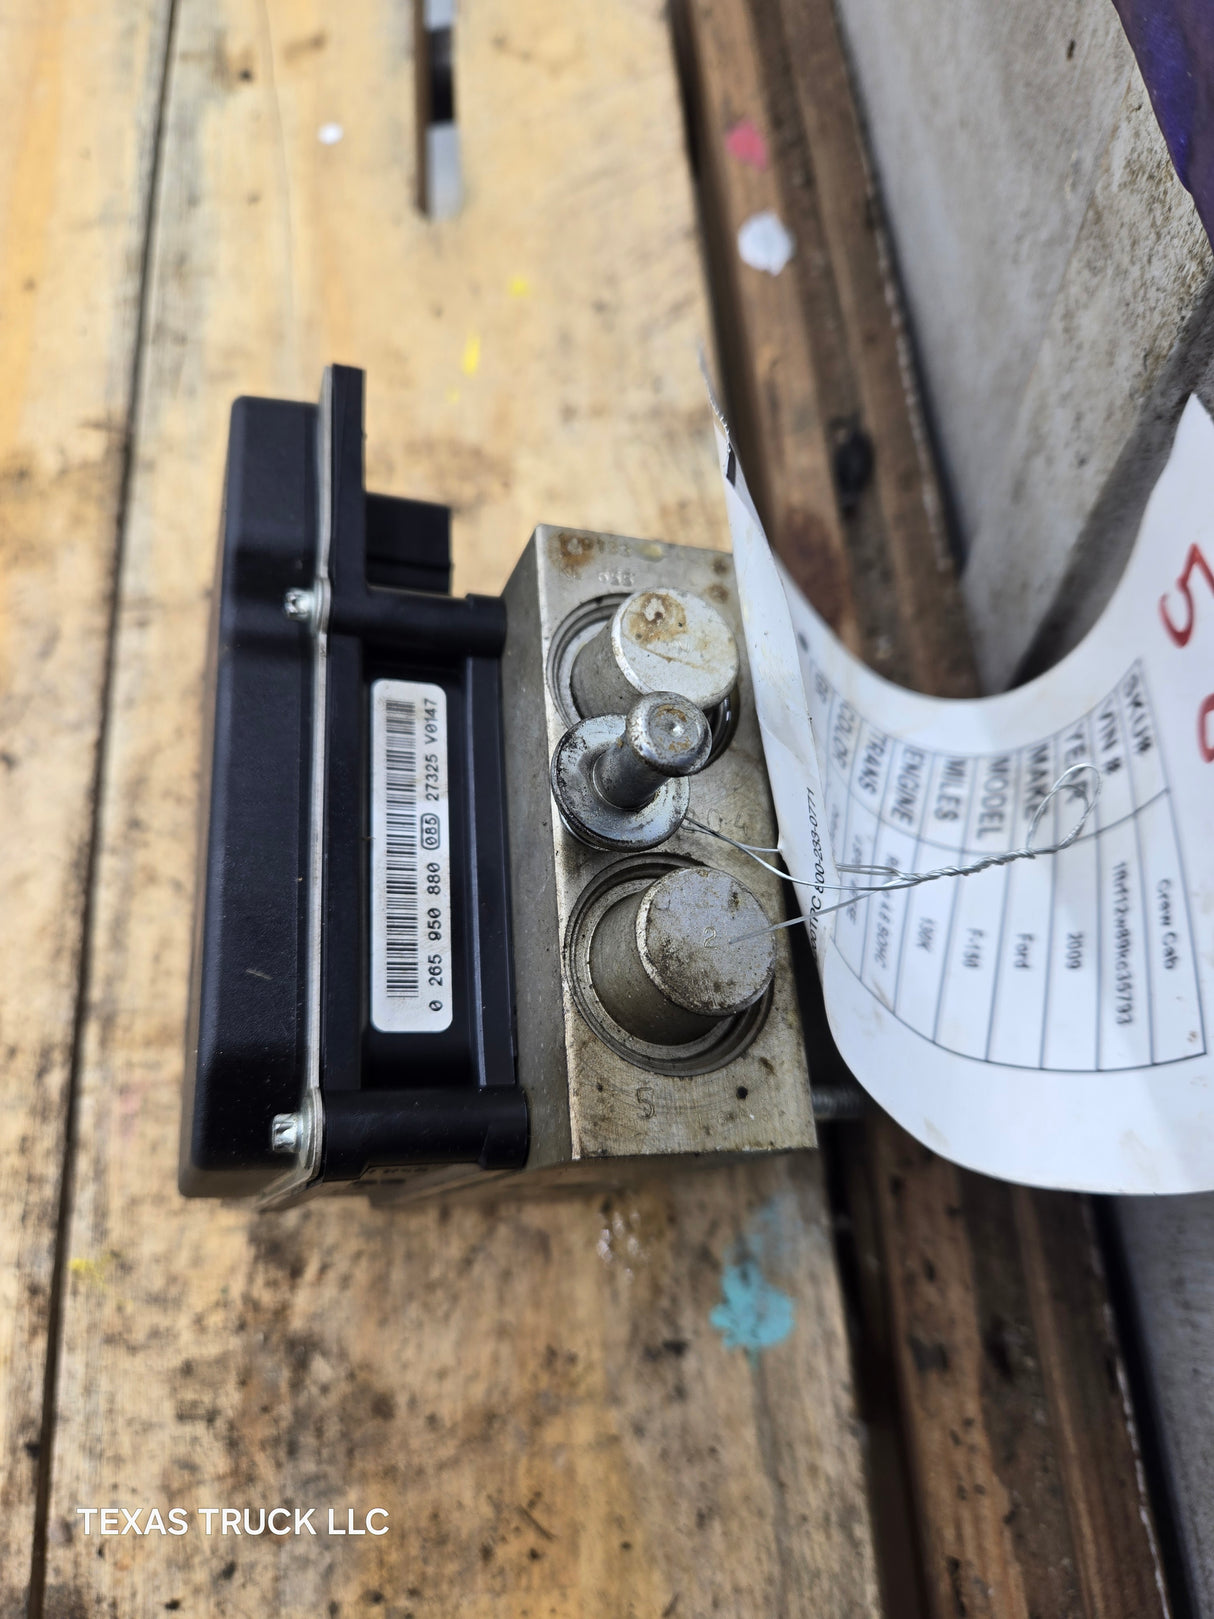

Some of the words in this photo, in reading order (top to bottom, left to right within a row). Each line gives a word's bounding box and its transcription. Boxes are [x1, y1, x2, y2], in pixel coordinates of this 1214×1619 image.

[424, 698, 438, 744] V0147
[833, 703, 856, 770] COLOR
[1099, 699, 1119, 752] VIN
[425, 754, 439, 801] 27325
[858, 732, 889, 795] TRANS
[891, 748, 927, 826] ENGINE
[1024, 743, 1050, 820] MAKE
[934, 758, 968, 821] MILES
[976, 757, 1010, 840] MODEL
[423, 817, 437, 846] 085
[806, 787, 824, 894] 800-233-0771
[426, 863, 440, 895] 880
[427, 908, 441, 941] 950
[1156, 879, 1173, 927] Crew
[427, 954, 442, 986] 265
[1015, 933, 1034, 970] Ford
[1066, 932, 1084, 970] 2009
[1162, 932, 1179, 970] Cab
[429, 1000, 442, 1011] 0
